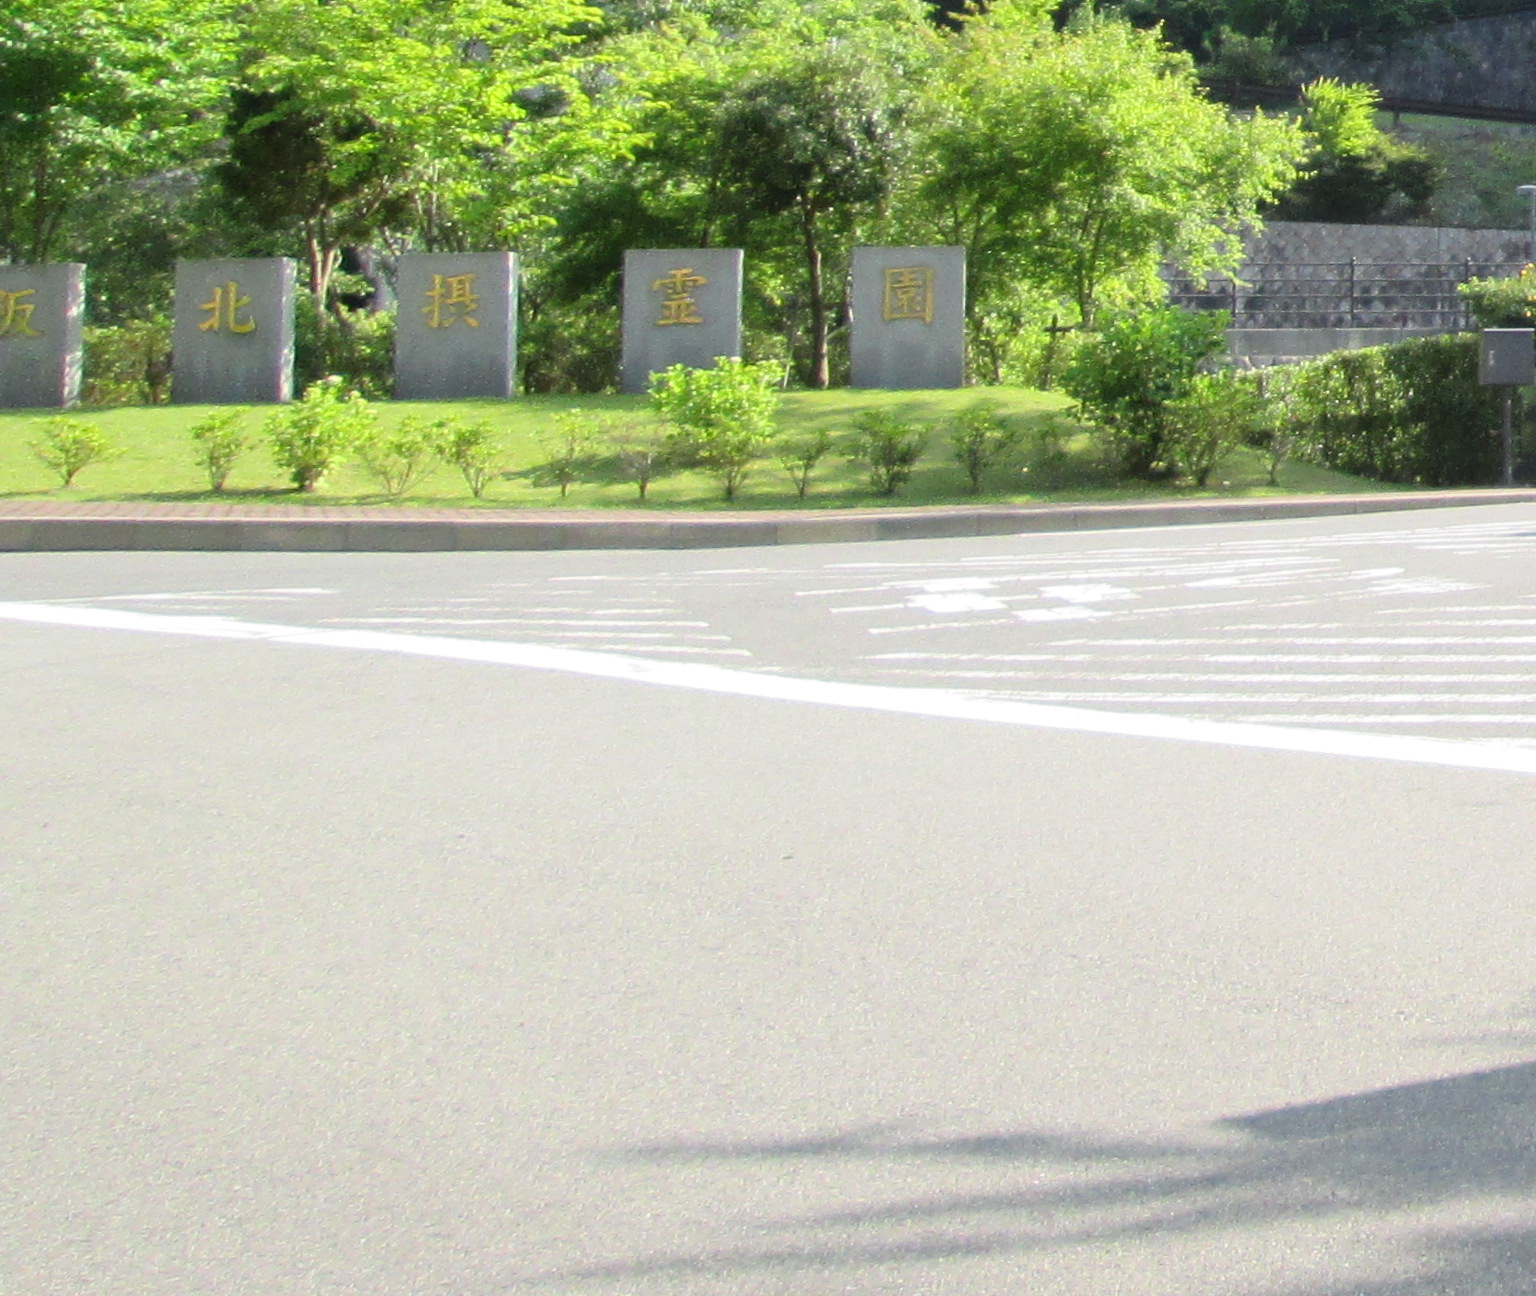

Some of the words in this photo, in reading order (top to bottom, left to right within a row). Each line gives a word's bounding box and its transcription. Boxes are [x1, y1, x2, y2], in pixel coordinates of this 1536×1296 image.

[197, 281, 257, 334] 北
[652, 267, 709, 326] 霊
[881, 266, 936, 324] 園
